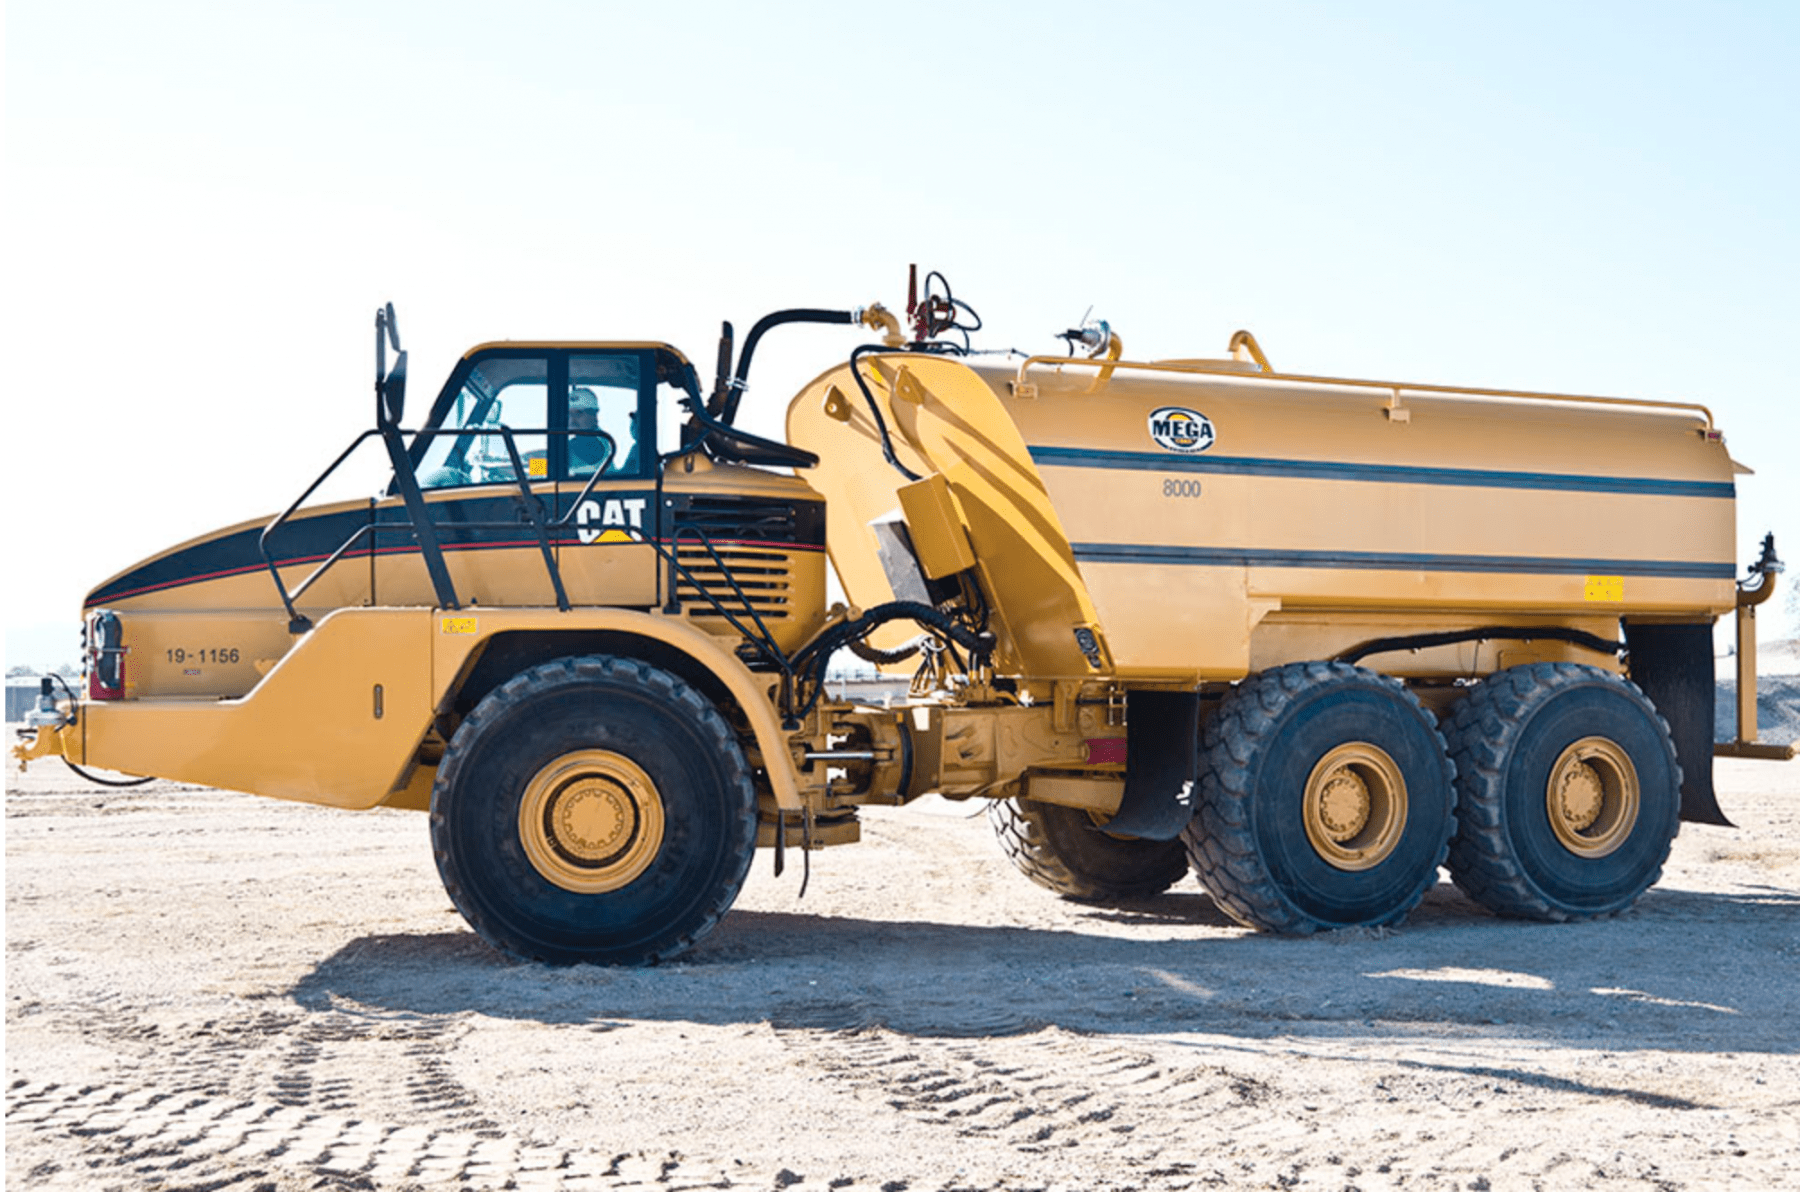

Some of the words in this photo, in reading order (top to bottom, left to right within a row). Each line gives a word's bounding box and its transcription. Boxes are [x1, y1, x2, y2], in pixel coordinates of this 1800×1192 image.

[1153, 420, 1213, 438] MEGA
[1163, 479, 1201, 497] 8000
[577, 499, 646, 543] CAT
[167, 648, 239, 663] 19-1156
